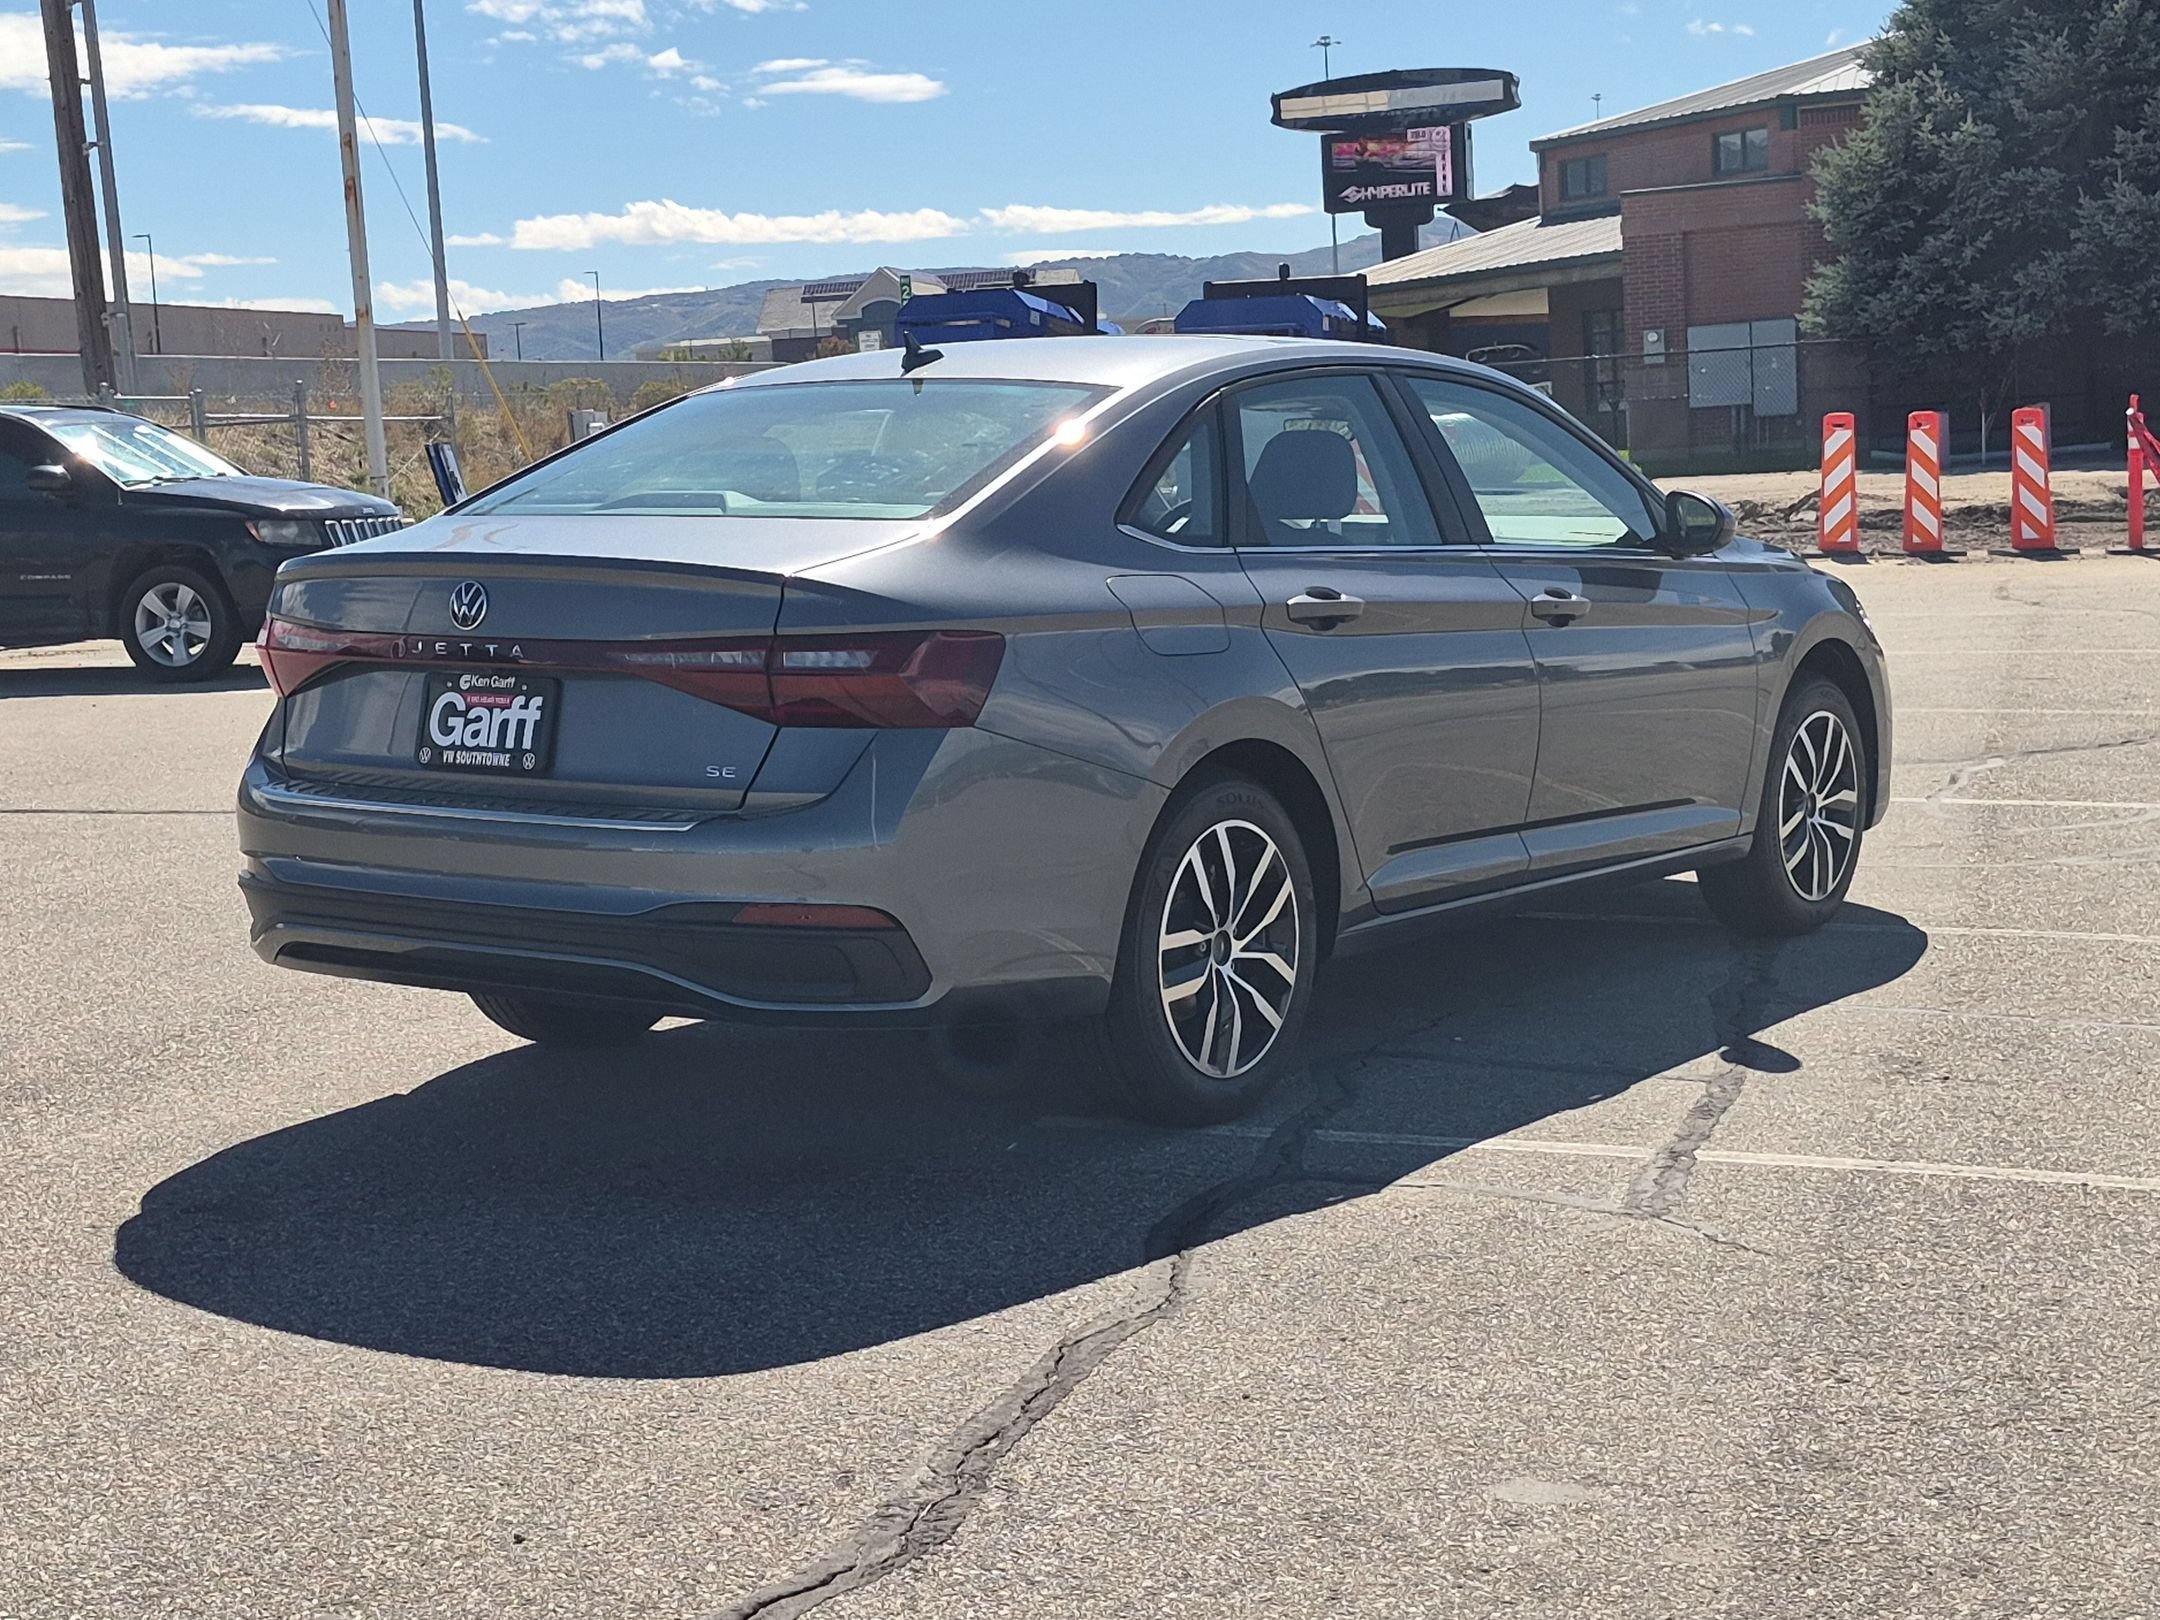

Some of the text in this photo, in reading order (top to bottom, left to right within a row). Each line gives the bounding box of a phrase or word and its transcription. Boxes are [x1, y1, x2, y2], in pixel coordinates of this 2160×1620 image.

[1362, 181, 1431, 201] HYPERLITE
[901, 285, 911, 299] 2
[412, 641, 524, 658] JETTA
[471, 674, 516, 689] Ken Garff
[429, 691, 544, 750] Garff
[456, 750, 512, 767] SOUTHTOWNE
[706, 765, 737, 778] SE
